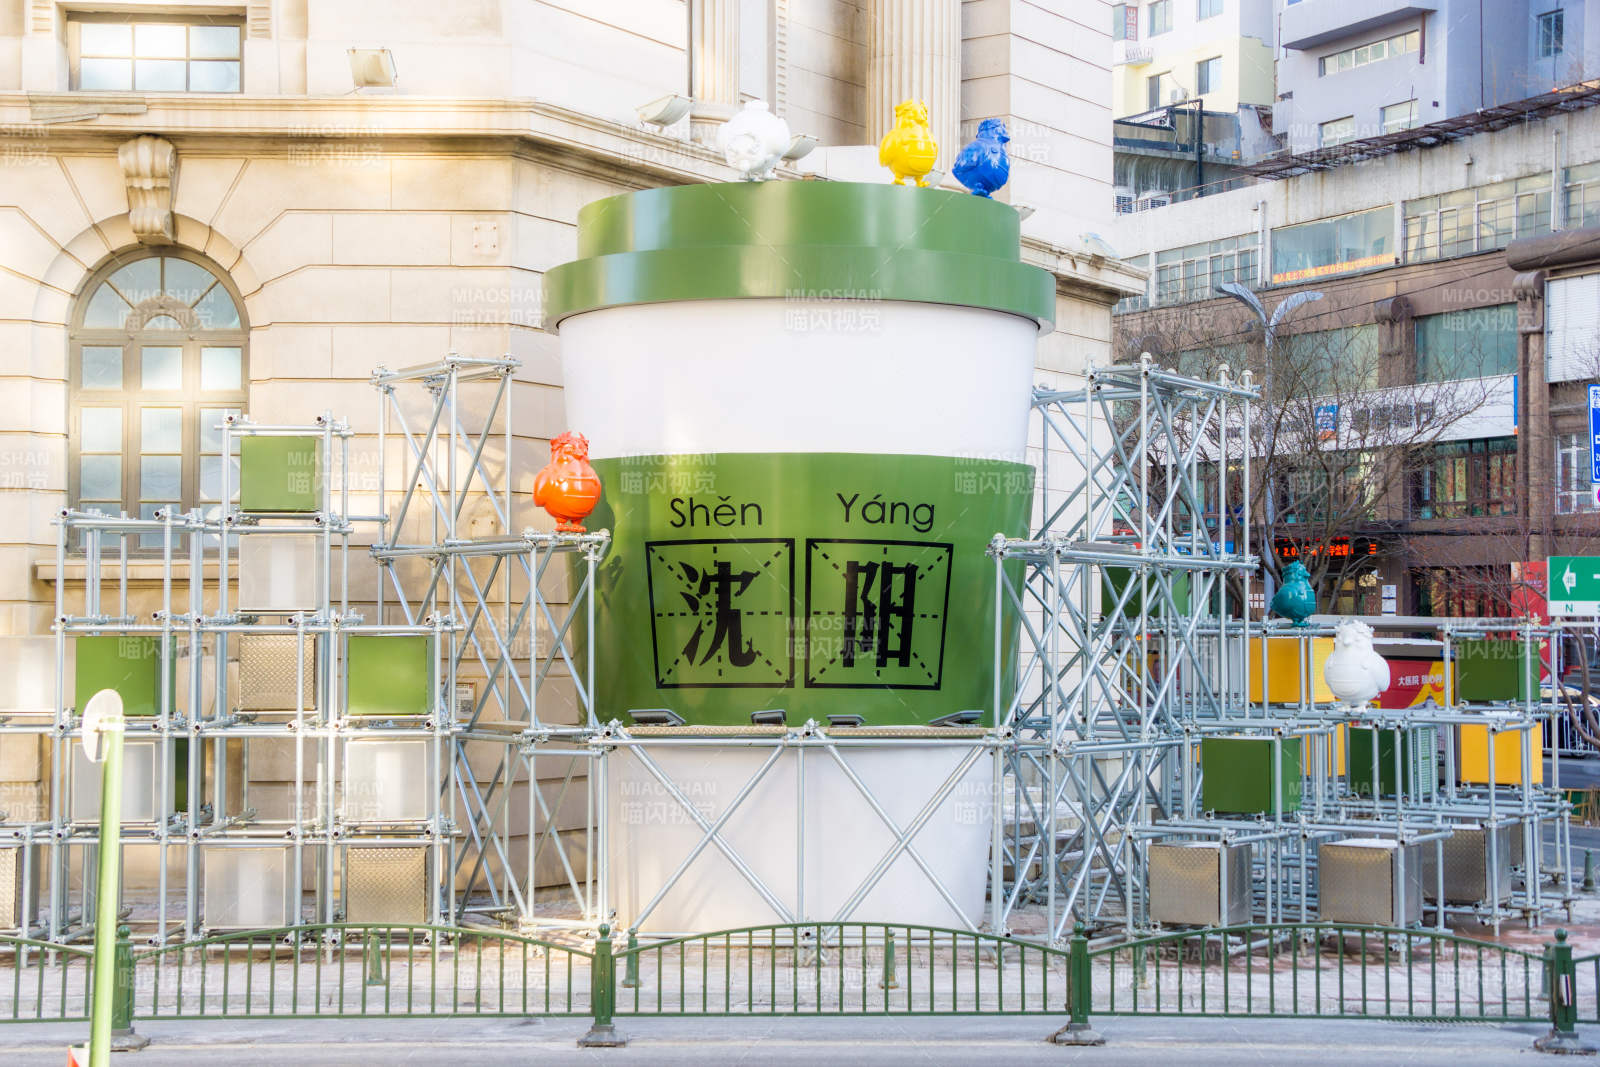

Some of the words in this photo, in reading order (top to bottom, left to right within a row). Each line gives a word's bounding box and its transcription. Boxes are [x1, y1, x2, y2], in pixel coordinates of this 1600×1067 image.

[670, 495, 763, 528] Shěn
[837, 493, 935, 533] Yáng
[1565, 603, 1573, 613] N
